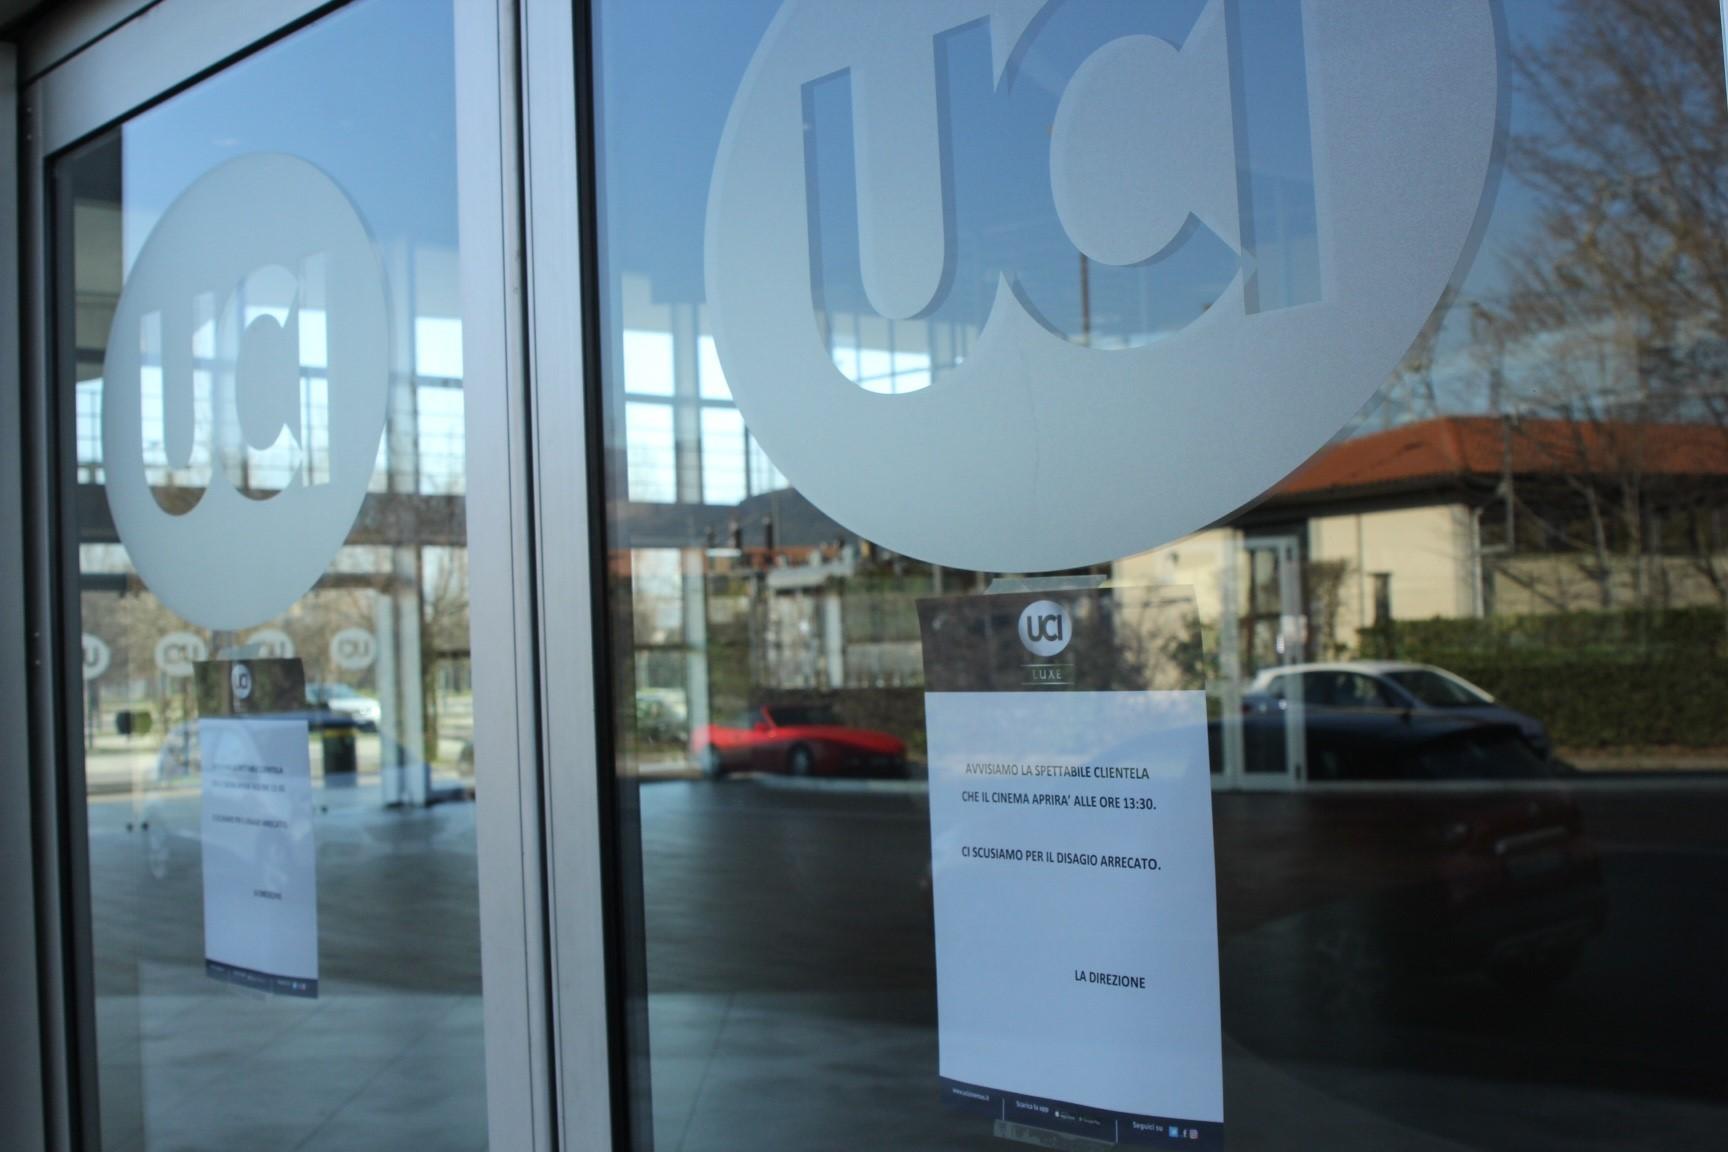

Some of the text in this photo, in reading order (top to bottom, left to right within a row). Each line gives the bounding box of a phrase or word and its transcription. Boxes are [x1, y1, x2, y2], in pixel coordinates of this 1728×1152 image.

[800, 0, 1322, 394] UCI
[140, 251, 330, 517] UCI
[1026, 614, 1063, 642] UCI
[1032, 669, 1062, 680] LUXE
[965, 763, 1150, 780] AVVISIAMO LA SPETTABILE CLIENTELA
[962, 791, 1157, 810] CHE IL CINEMA APRIRA' ALLE ORE 13:30.
[962, 846, 1161, 870] CI SCUSIAMO PER IL DISAGIO ARRECATO.
[1075, 969, 1146, 989] LA DIREZIONE
[1132, 1121, 1154, 1131] Seguici
